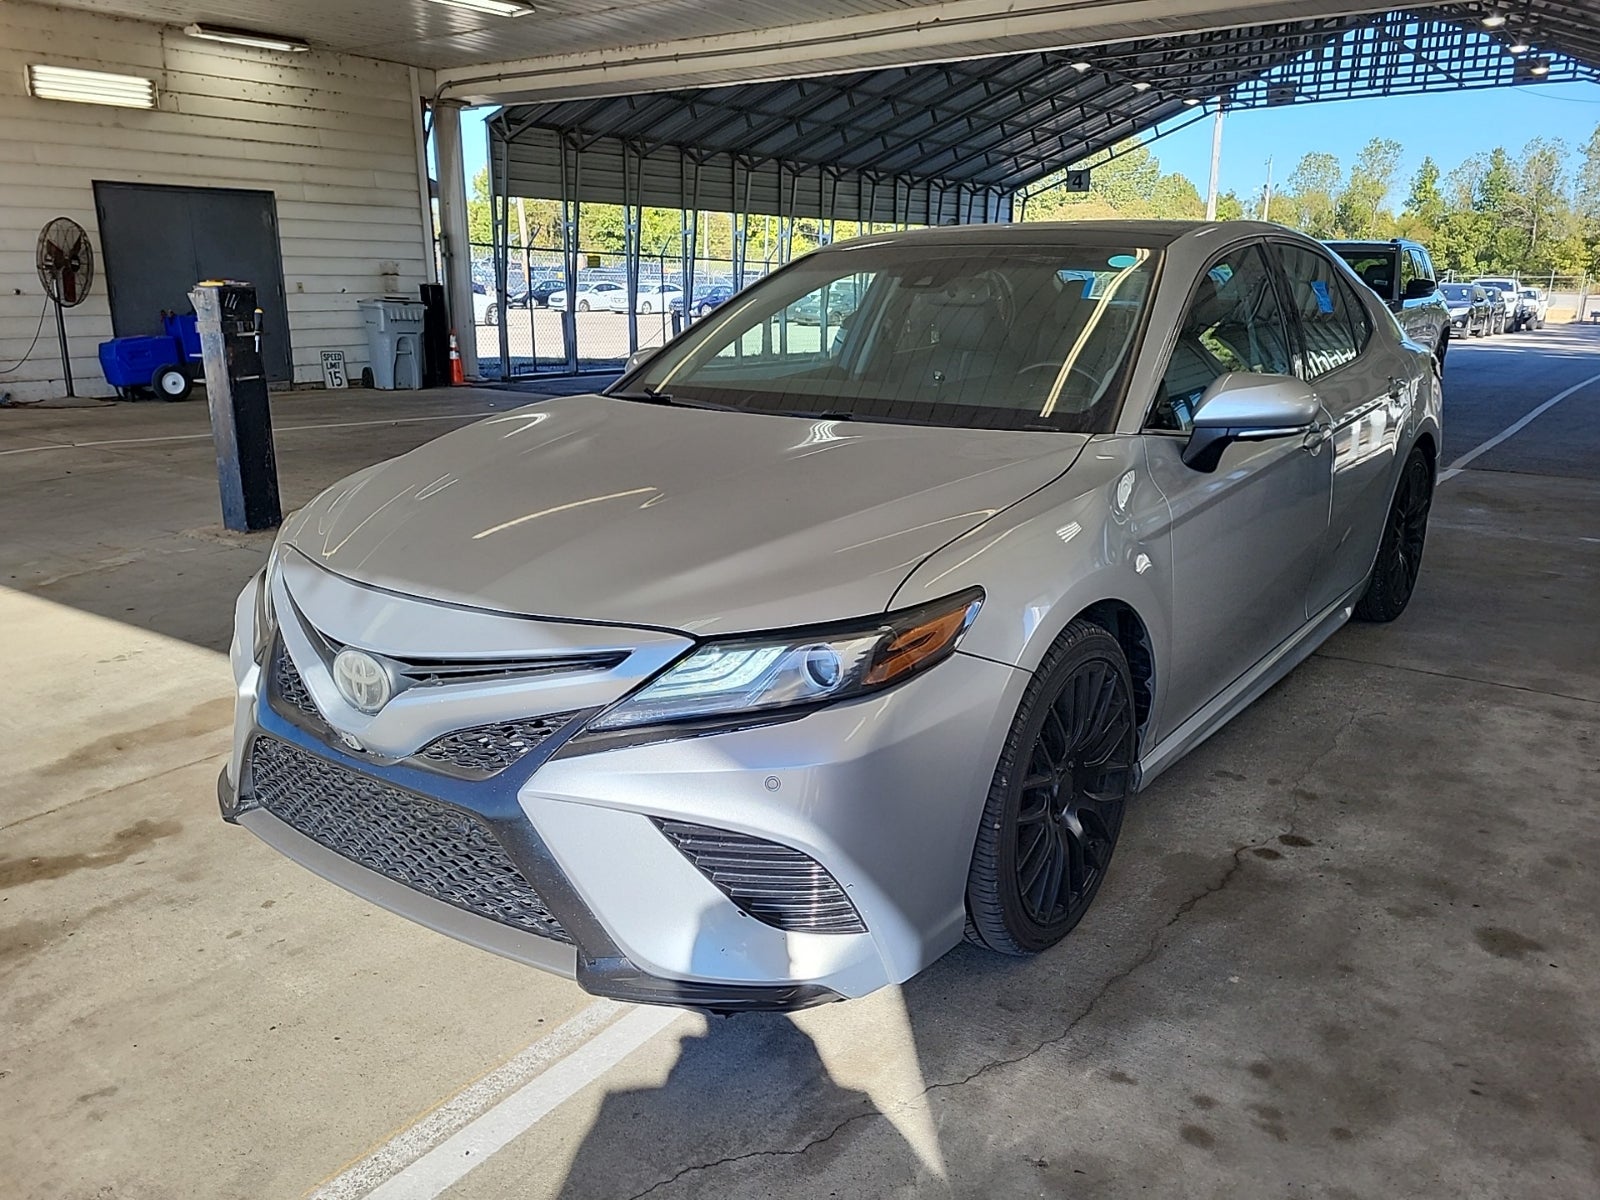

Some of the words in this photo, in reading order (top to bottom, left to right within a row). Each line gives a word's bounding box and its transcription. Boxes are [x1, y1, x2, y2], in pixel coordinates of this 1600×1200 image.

[1072, 174, 1083, 189] 4
[323, 353, 342, 361] SPEED
[326, 361, 341, 370] LIMIT
[328, 371, 343, 387] 15
